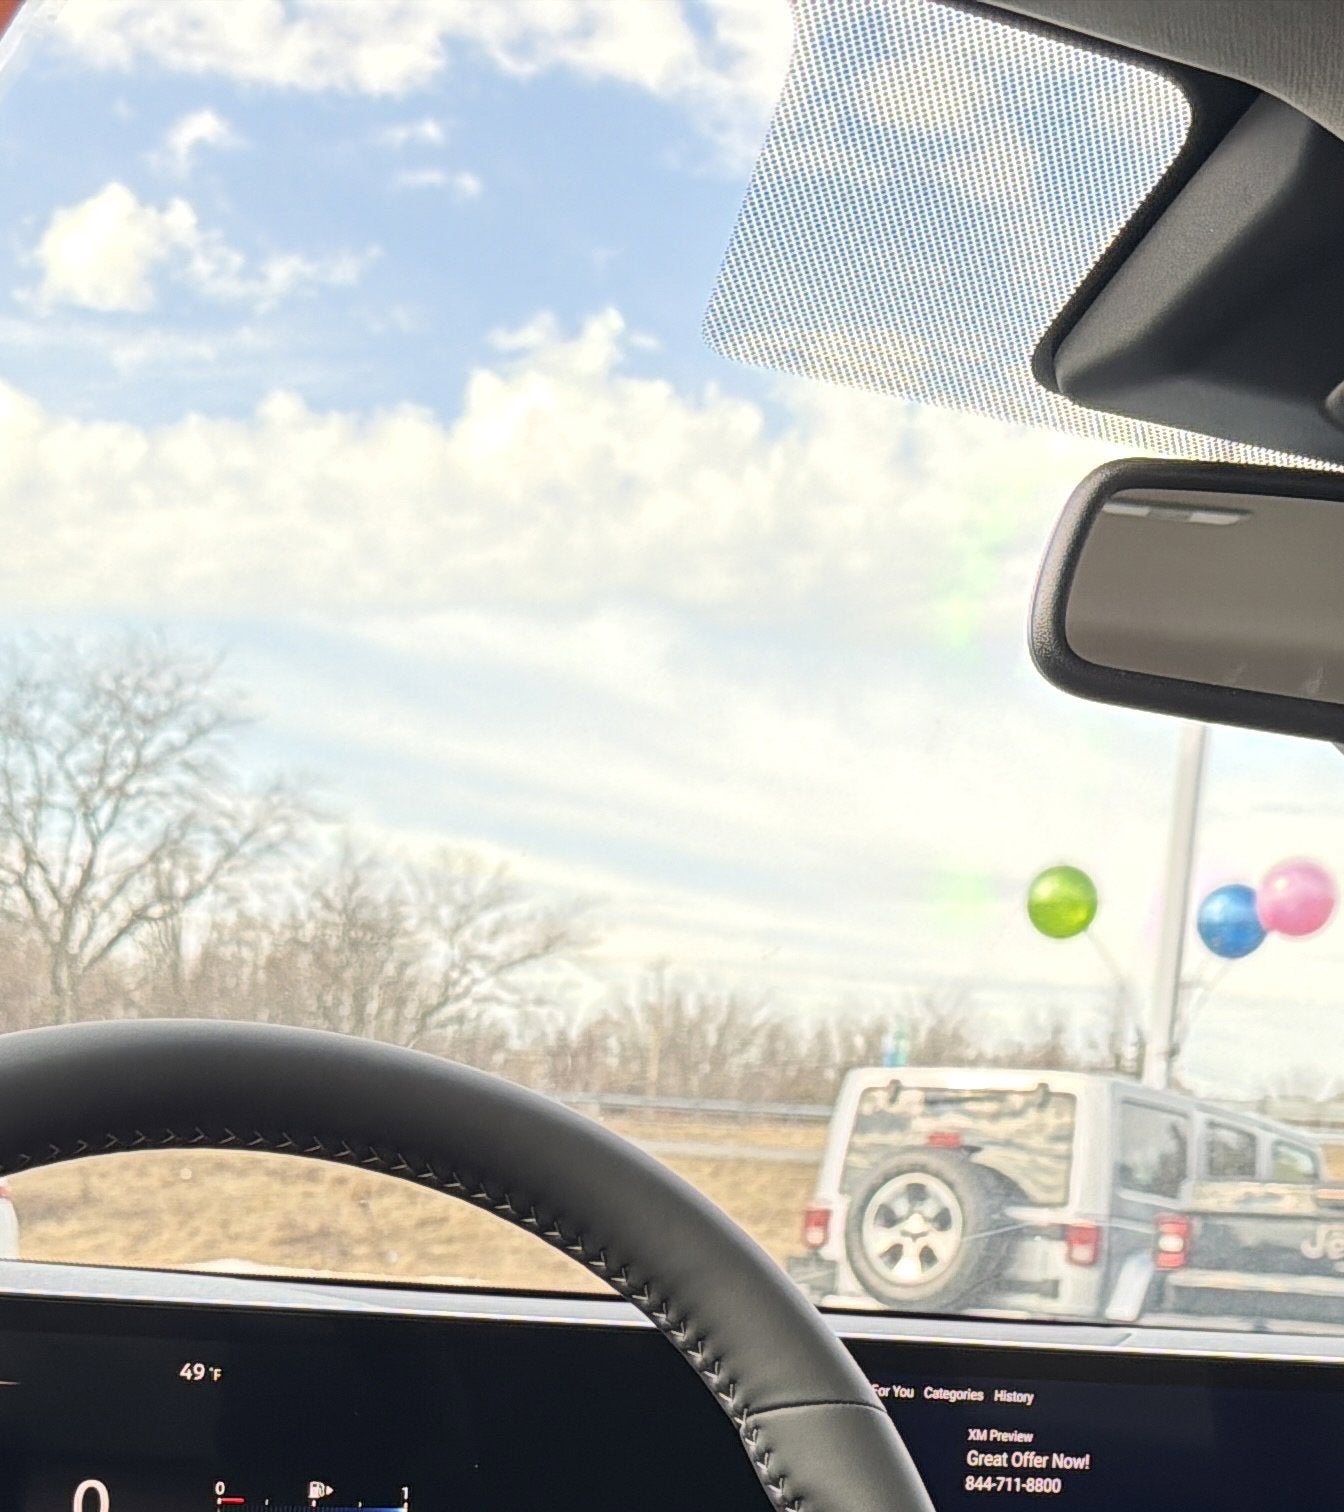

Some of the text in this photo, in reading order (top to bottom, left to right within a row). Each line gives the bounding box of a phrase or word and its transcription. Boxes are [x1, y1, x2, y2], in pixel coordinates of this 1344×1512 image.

[179, 1363, 205, 1381] 49
[893, 1386, 915, 1398] You
[923, 1386, 984, 1403] Categories
[994, 1390, 1034, 1405] History
[967, 1428, 1034, 1443] XM Preview
[966, 1450, 1091, 1470] Great Offer Now!
[215, 1481, 225, 1495] 0
[965, 1475, 1062, 1493] 844-711-8800
[401, 1487, 409, 1499] 1
